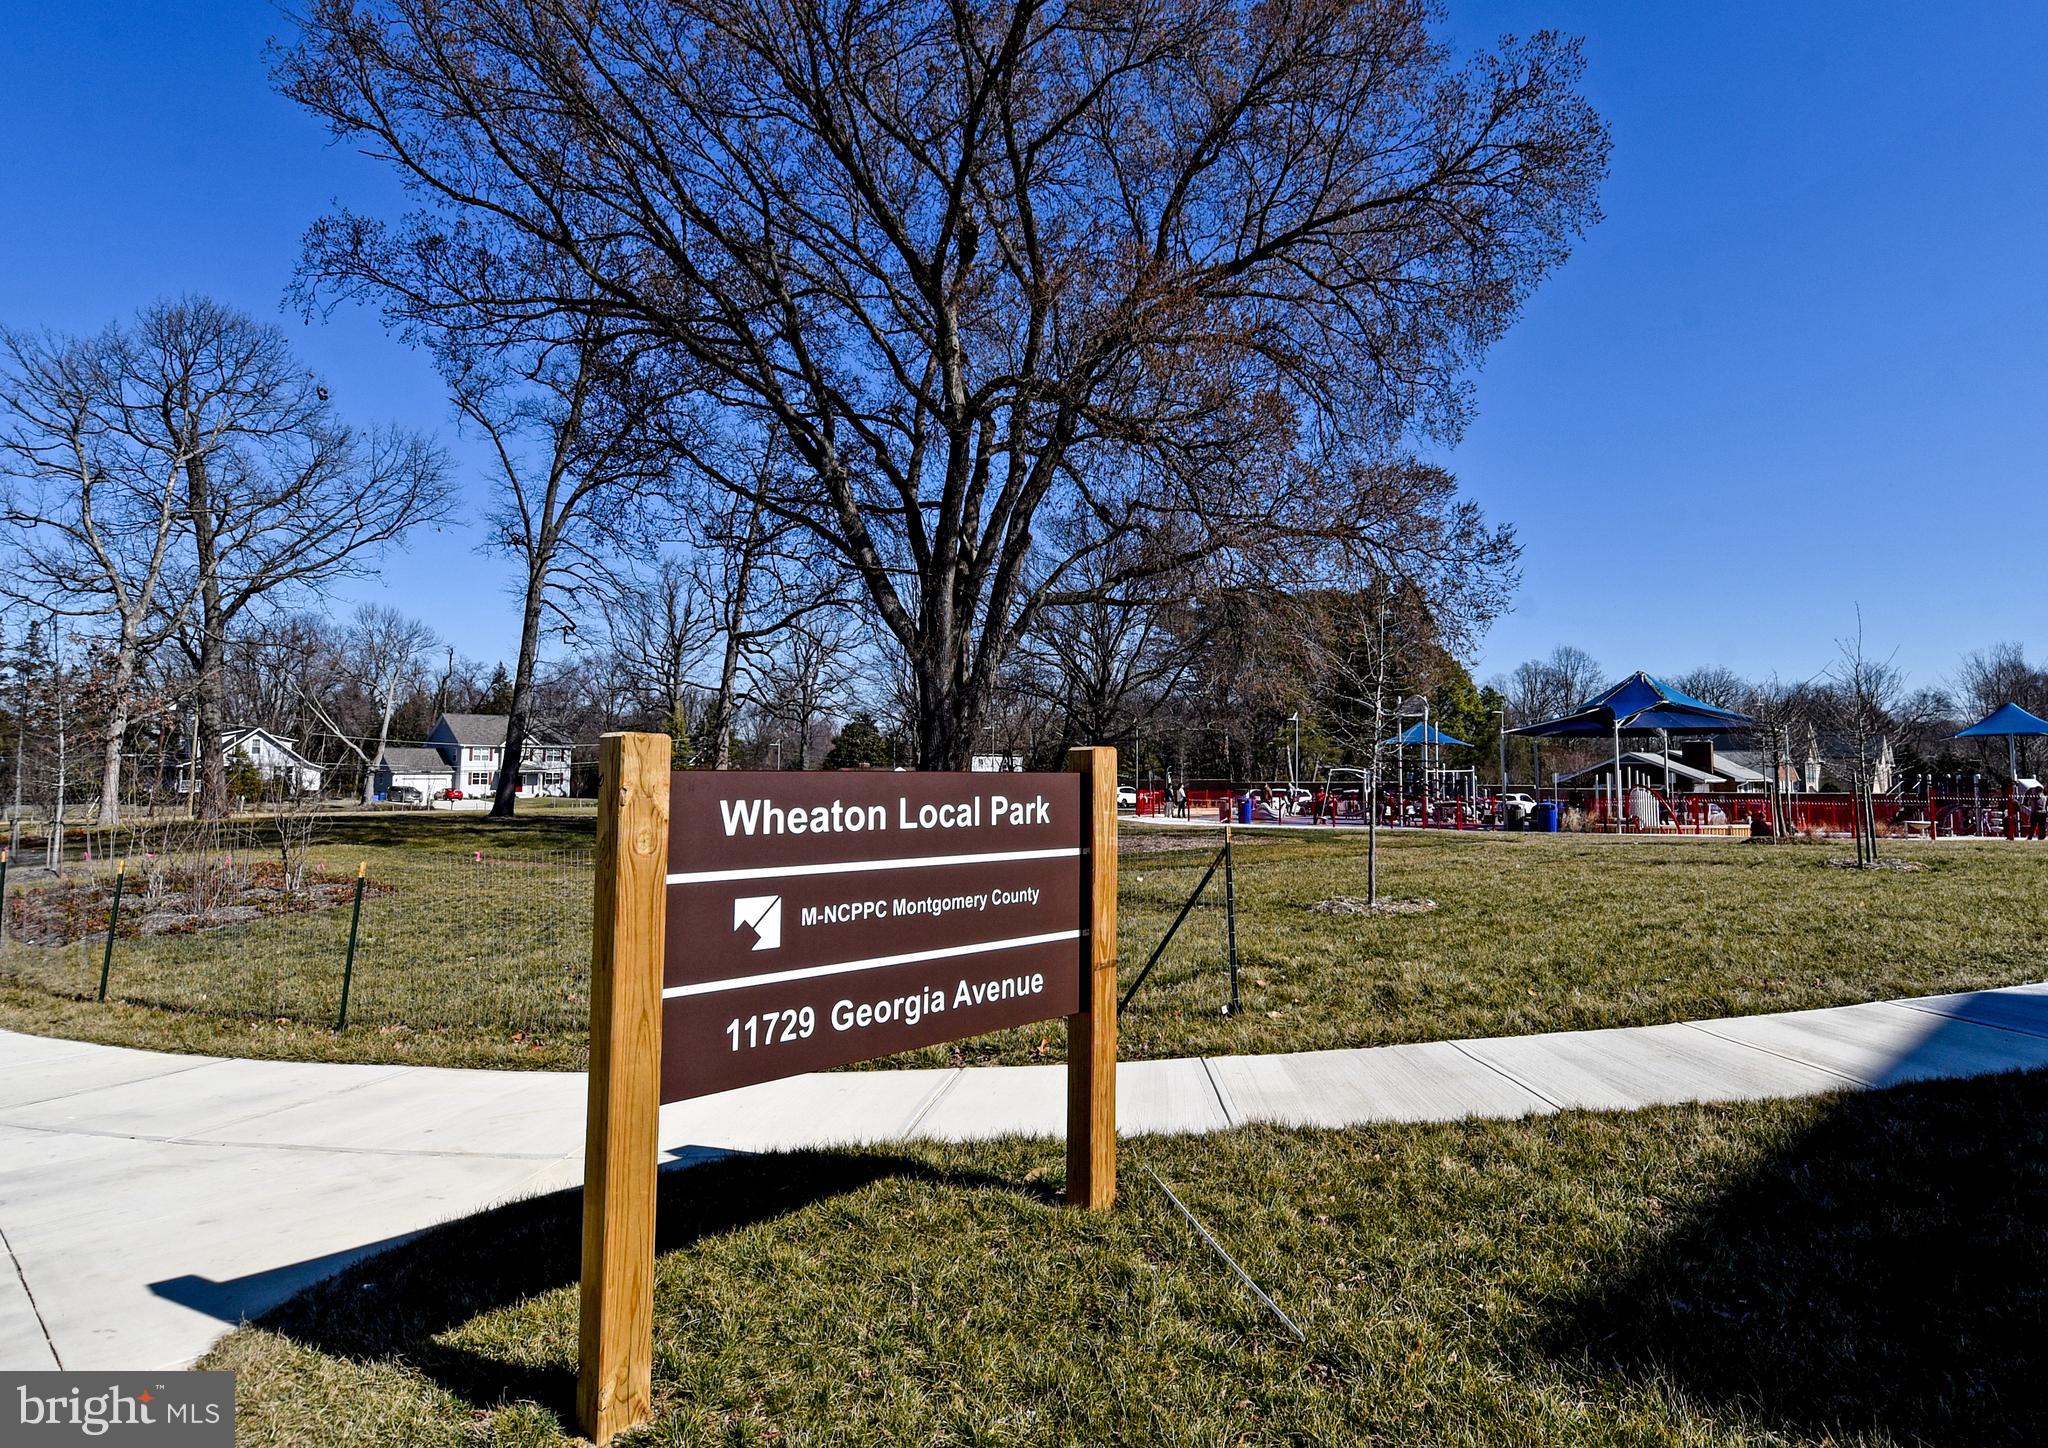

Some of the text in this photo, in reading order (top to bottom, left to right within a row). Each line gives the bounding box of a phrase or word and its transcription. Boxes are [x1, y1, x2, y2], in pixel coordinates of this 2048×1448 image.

[720, 796, 1050, 836] Wheaton Local Park
[802, 887, 1039, 926] M-NCPPC Montgomery County
[727, 974, 1043, 1051] 11729 Georgia Avenue
